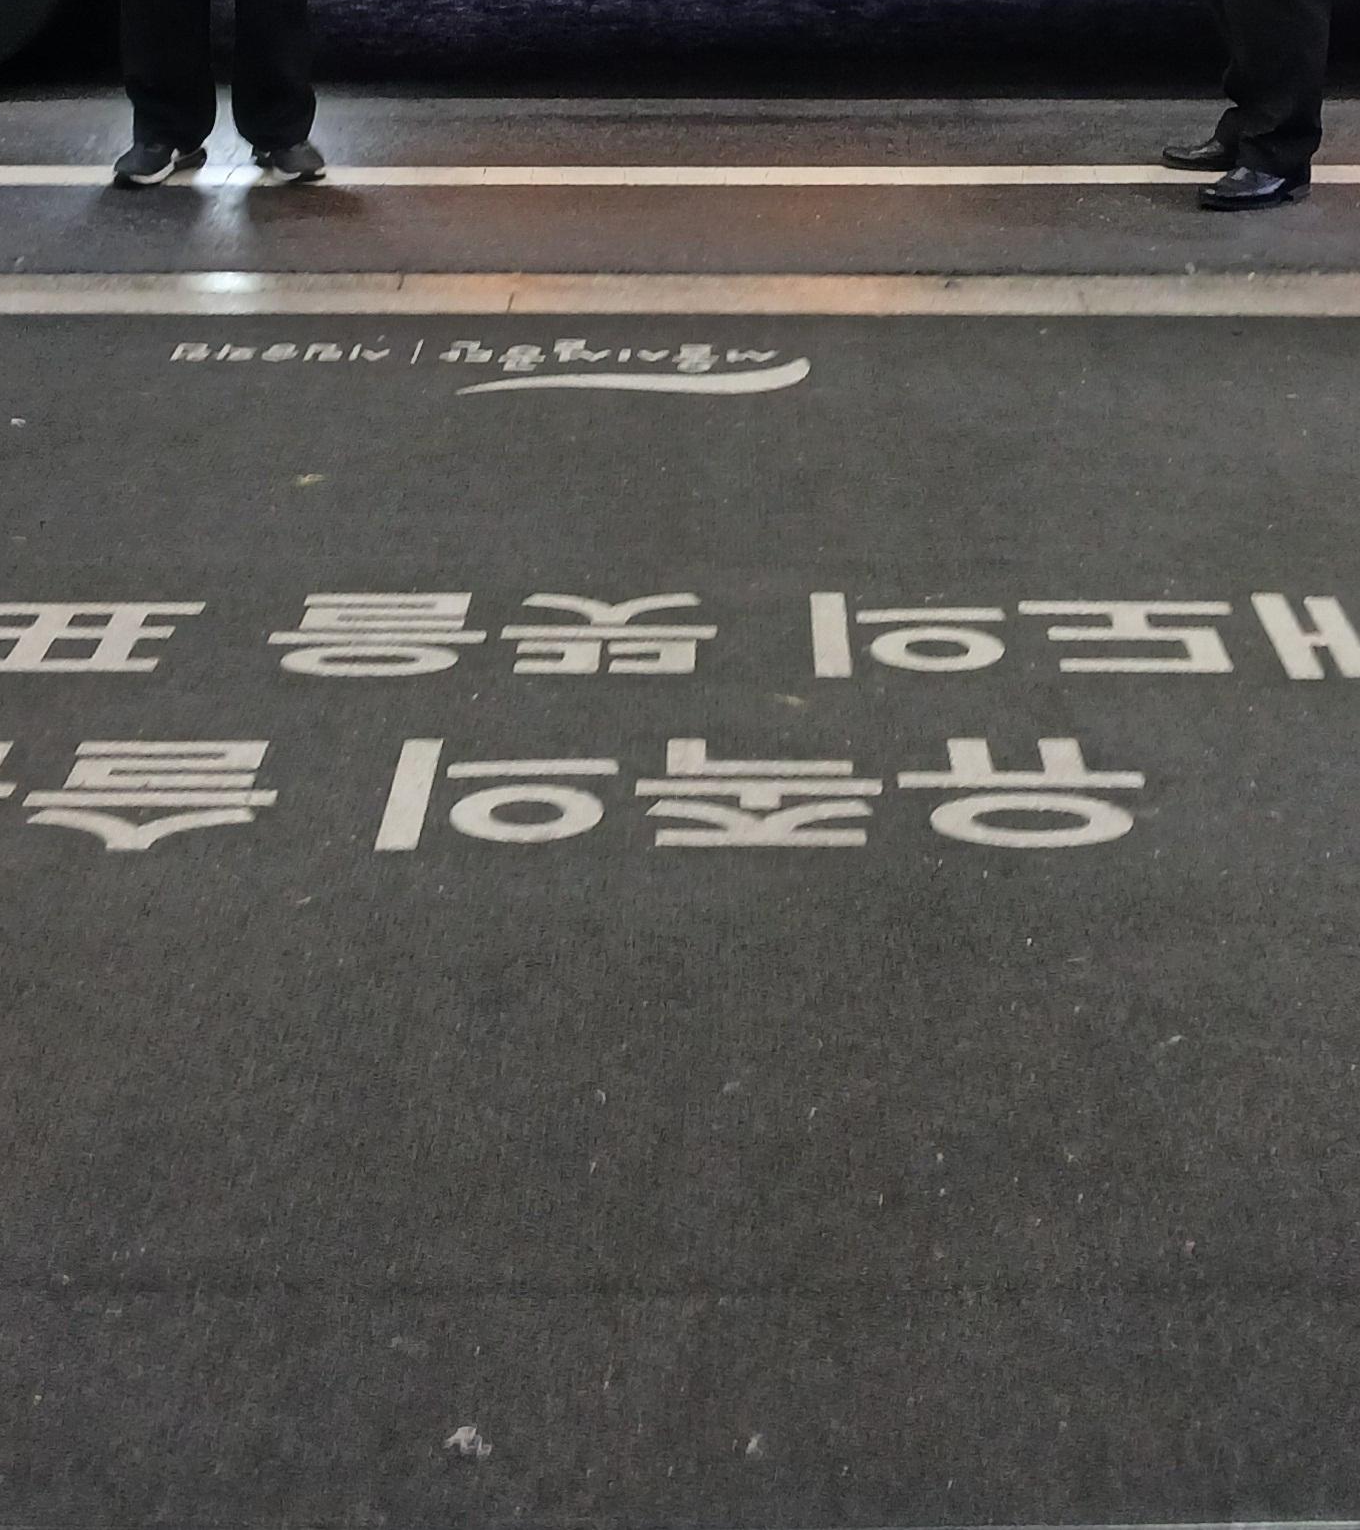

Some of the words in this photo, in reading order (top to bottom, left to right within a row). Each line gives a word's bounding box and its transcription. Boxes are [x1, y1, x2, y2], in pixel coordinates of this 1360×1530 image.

[439, 337, 780, 373] 서울시설공단
[267, 590, 719, 678] 뜻을
[373, 737, 1147, 853] 유족의
